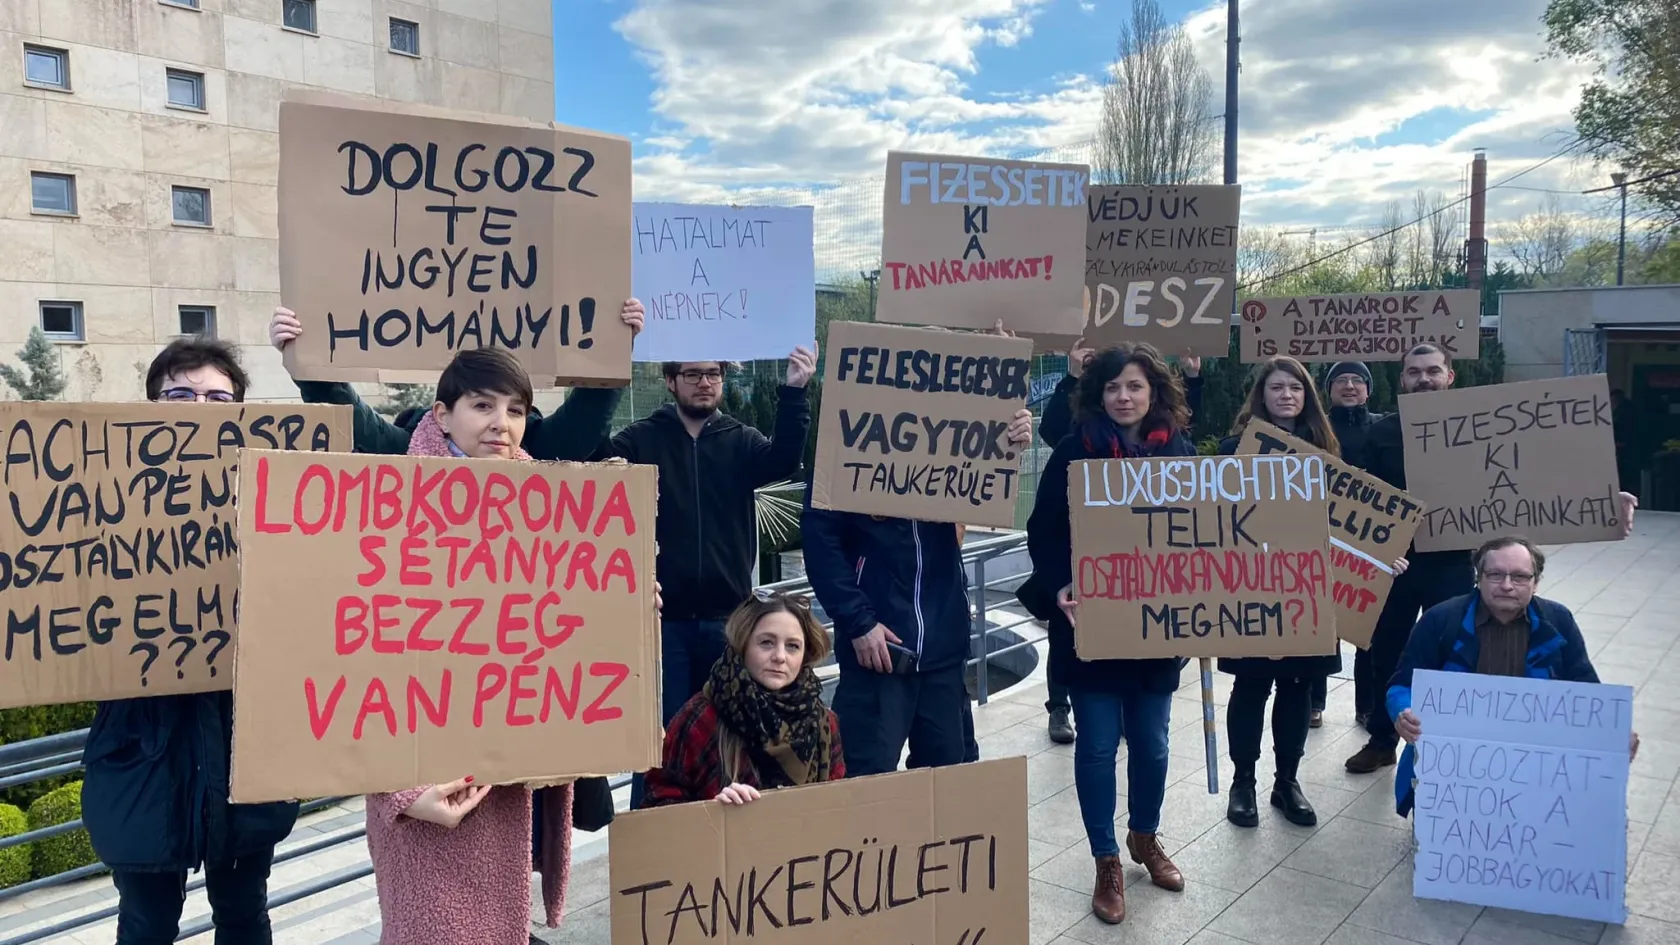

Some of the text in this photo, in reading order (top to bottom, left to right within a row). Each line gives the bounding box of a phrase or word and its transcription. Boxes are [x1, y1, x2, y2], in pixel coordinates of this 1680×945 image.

[338, 141, 599, 198] DOLGOZZ
[900, 161, 1088, 207] FIZESSÉTEK
[425, 206, 518, 246] TE
[963, 205, 989, 234] KI
[1087, 189, 1199, 223] VÉDJÜK
[635, 215, 772, 255] HATALMAT
[962, 234, 986, 260] A
[1086, 225, 1238, 251] MEKEINKET
[361, 245, 538, 298] INGYEN
[690, 257, 710, 287] A
[886, 255, 1053, 291] TANÁRAINKAT!
[327, 297, 597, 351] HOMÁNYI!
[651, 288, 748, 320] NÉPNEK!
[1282, 294, 1451, 318] A TANÁROK A
[1293, 314, 1425, 336] DIÁKOKÉRT
[1256, 338, 1279, 357] IS
[837, 346, 1031, 400] FELESLEGESEK
[1411, 392, 1612, 453] FIZESSÉTEK
[0, 407, 330, 485] ACHTOZÁSRA
[1485, 442, 1519, 471] KI
[9, 463, 238, 536] VAN PÉN
[255, 457, 637, 537] LOMBKORONA
[843, 461, 1017, 507] TANKERÜLET
[1488, 470, 1519, 499] A
[1422, 484, 1619, 537] TANÁRAINKAT!
[357, 520, 637, 593] SÉTÁNYRA
[133, 584, 238, 639] ELM
[334, 591, 584, 656] BEZZEG
[304, 647, 631, 740] VAN PÉNZ
[1420, 781, 1570, 827] JÁTOK A
[618, 834, 996, 945] TANKERÜLETI
[1424, 850, 1617, 901] JOBBÁGYOKAT
